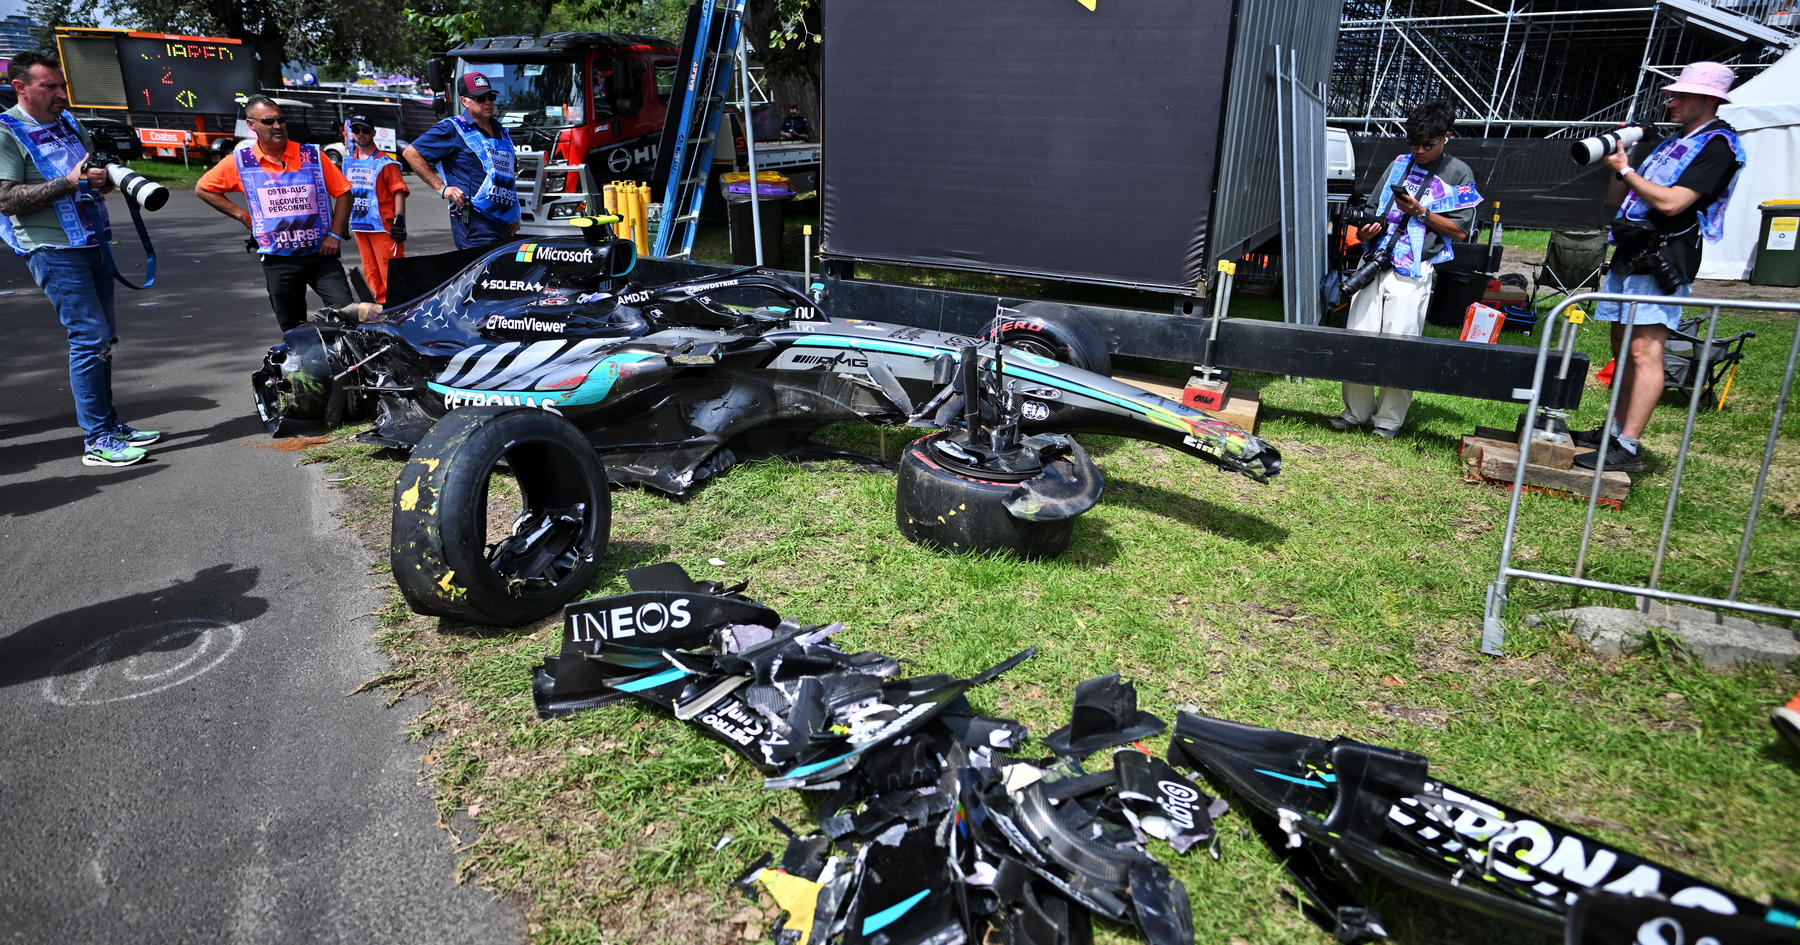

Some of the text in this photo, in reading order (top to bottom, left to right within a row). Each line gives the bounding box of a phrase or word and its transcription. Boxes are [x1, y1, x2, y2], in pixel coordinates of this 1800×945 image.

[150, 131, 178, 141] Coates
[634, 144, 659, 164] HI
[268, 203, 314, 213] PERSONNEL
[269, 197, 309, 206] RECOVERY
[270, 227, 320, 243] COURSE
[536, 246, 594, 264] Microsoft
[489, 279, 535, 292] SOLERA
[687, 278, 740, 296] CROWDSTRIKE
[617, 293, 640, 306] AMD
[497, 315, 567, 333] TeamViewer
[571, 598, 691, 643] INEOS
[702, 712, 756, 747] PETRO
